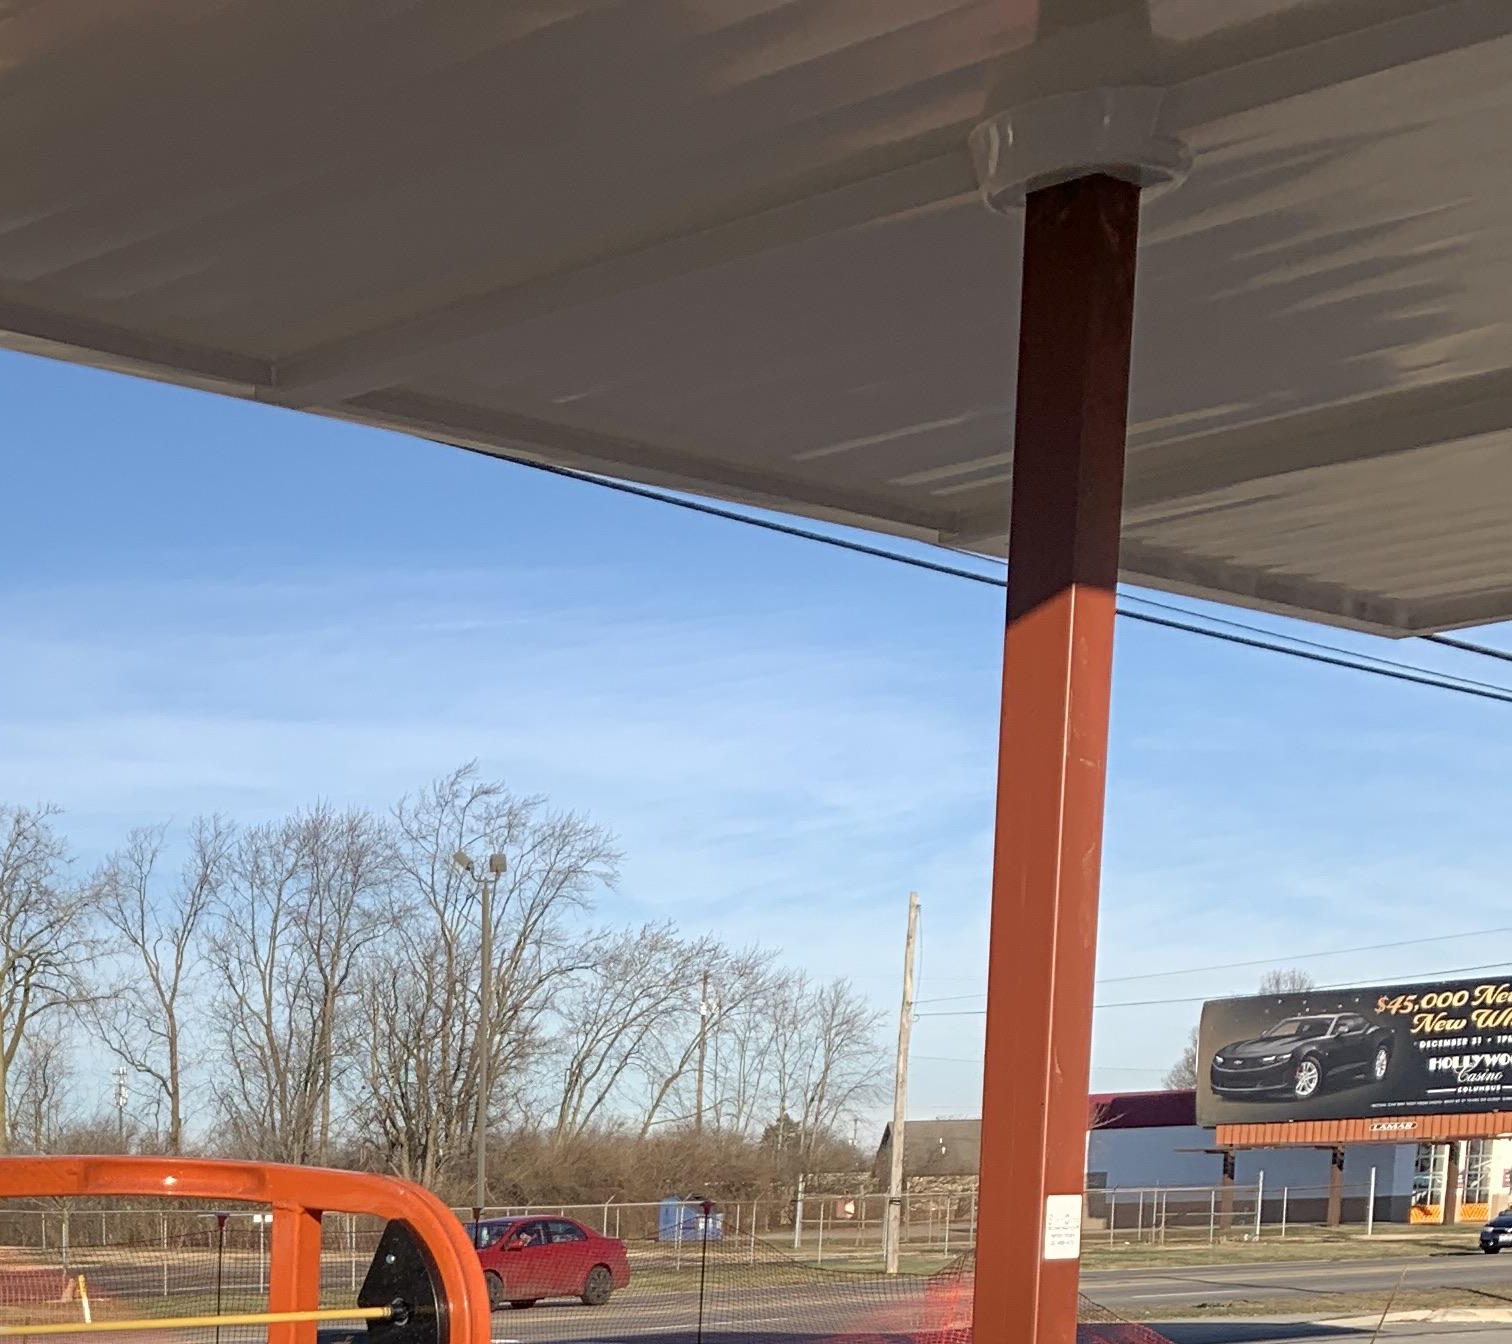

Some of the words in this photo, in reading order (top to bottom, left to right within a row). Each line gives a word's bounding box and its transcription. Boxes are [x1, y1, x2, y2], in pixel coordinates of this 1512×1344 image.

[1374, 990, 1469, 1015] $45,000
[1471, 983, 1512, 1006] Ne
[1410, 1012, 1467, 1033] New
[1419, 1037, 1468, 1049] DECEMBER
[1428, 1053, 1512, 1071] HOLLYWO
[1456, 1067, 1503, 1083] Casino
[1457, 1085, 1501, 1094] COLUMBUS
